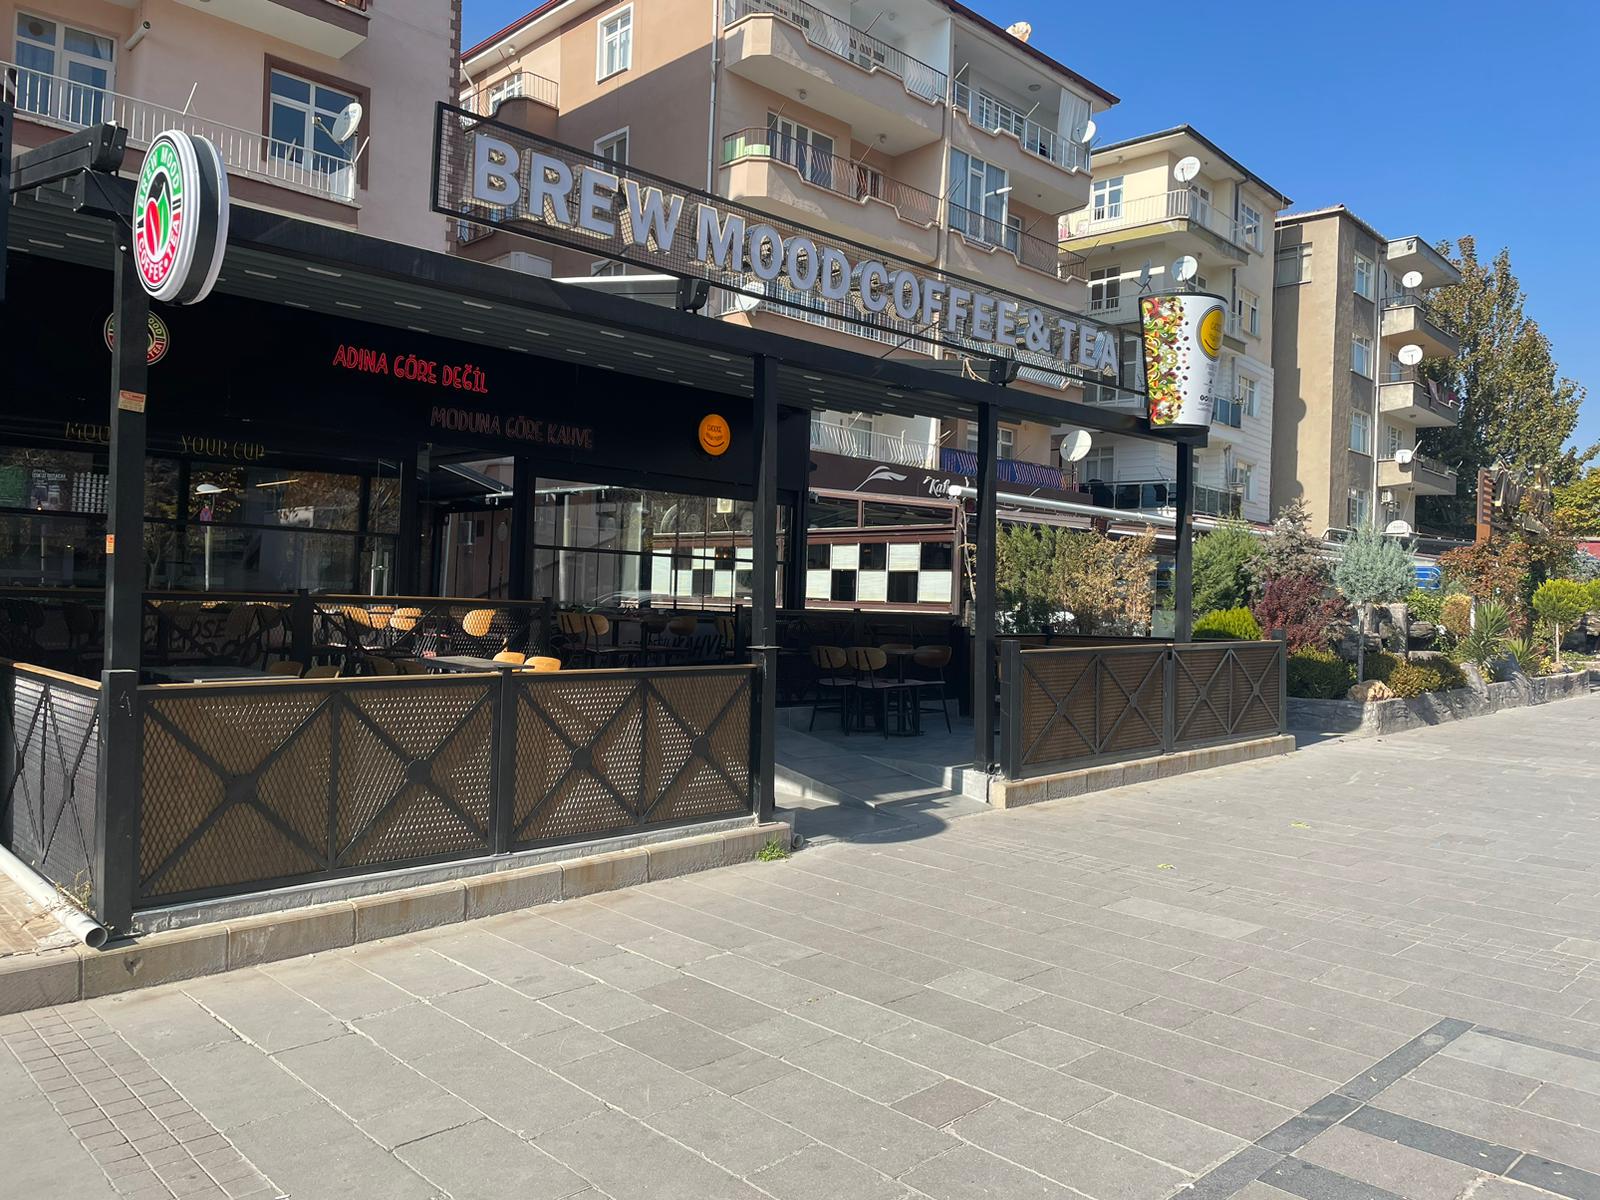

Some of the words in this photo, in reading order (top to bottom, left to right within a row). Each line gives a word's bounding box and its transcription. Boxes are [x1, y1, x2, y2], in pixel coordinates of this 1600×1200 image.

[138, 151, 159, 208] BREW
[160, 146, 180, 190] MOOD
[138, 238, 165, 281] COFFEE
[167, 219, 181, 259] TEA
[472, 132, 685, 252] BREW
[696, 202, 852, 300] MOOD
[856, 259, 1018, 346] COFFEE
[1024, 306, 1053, 355] &
[1057, 318, 1120, 374] TEA
[147, 317, 162, 335] OOD
[149, 344, 163, 357] TEA
[333, 344, 388, 375] ADINA
[394, 354, 437, 385] GÖRE
[441, 364, 488, 393] DEĞİL
[431, 406, 500, 435] MODUNA
[505, 416, 543, 442] GÖRE
[181, 434, 228, 458] YOUR
[233, 441, 265, 461] CUP
